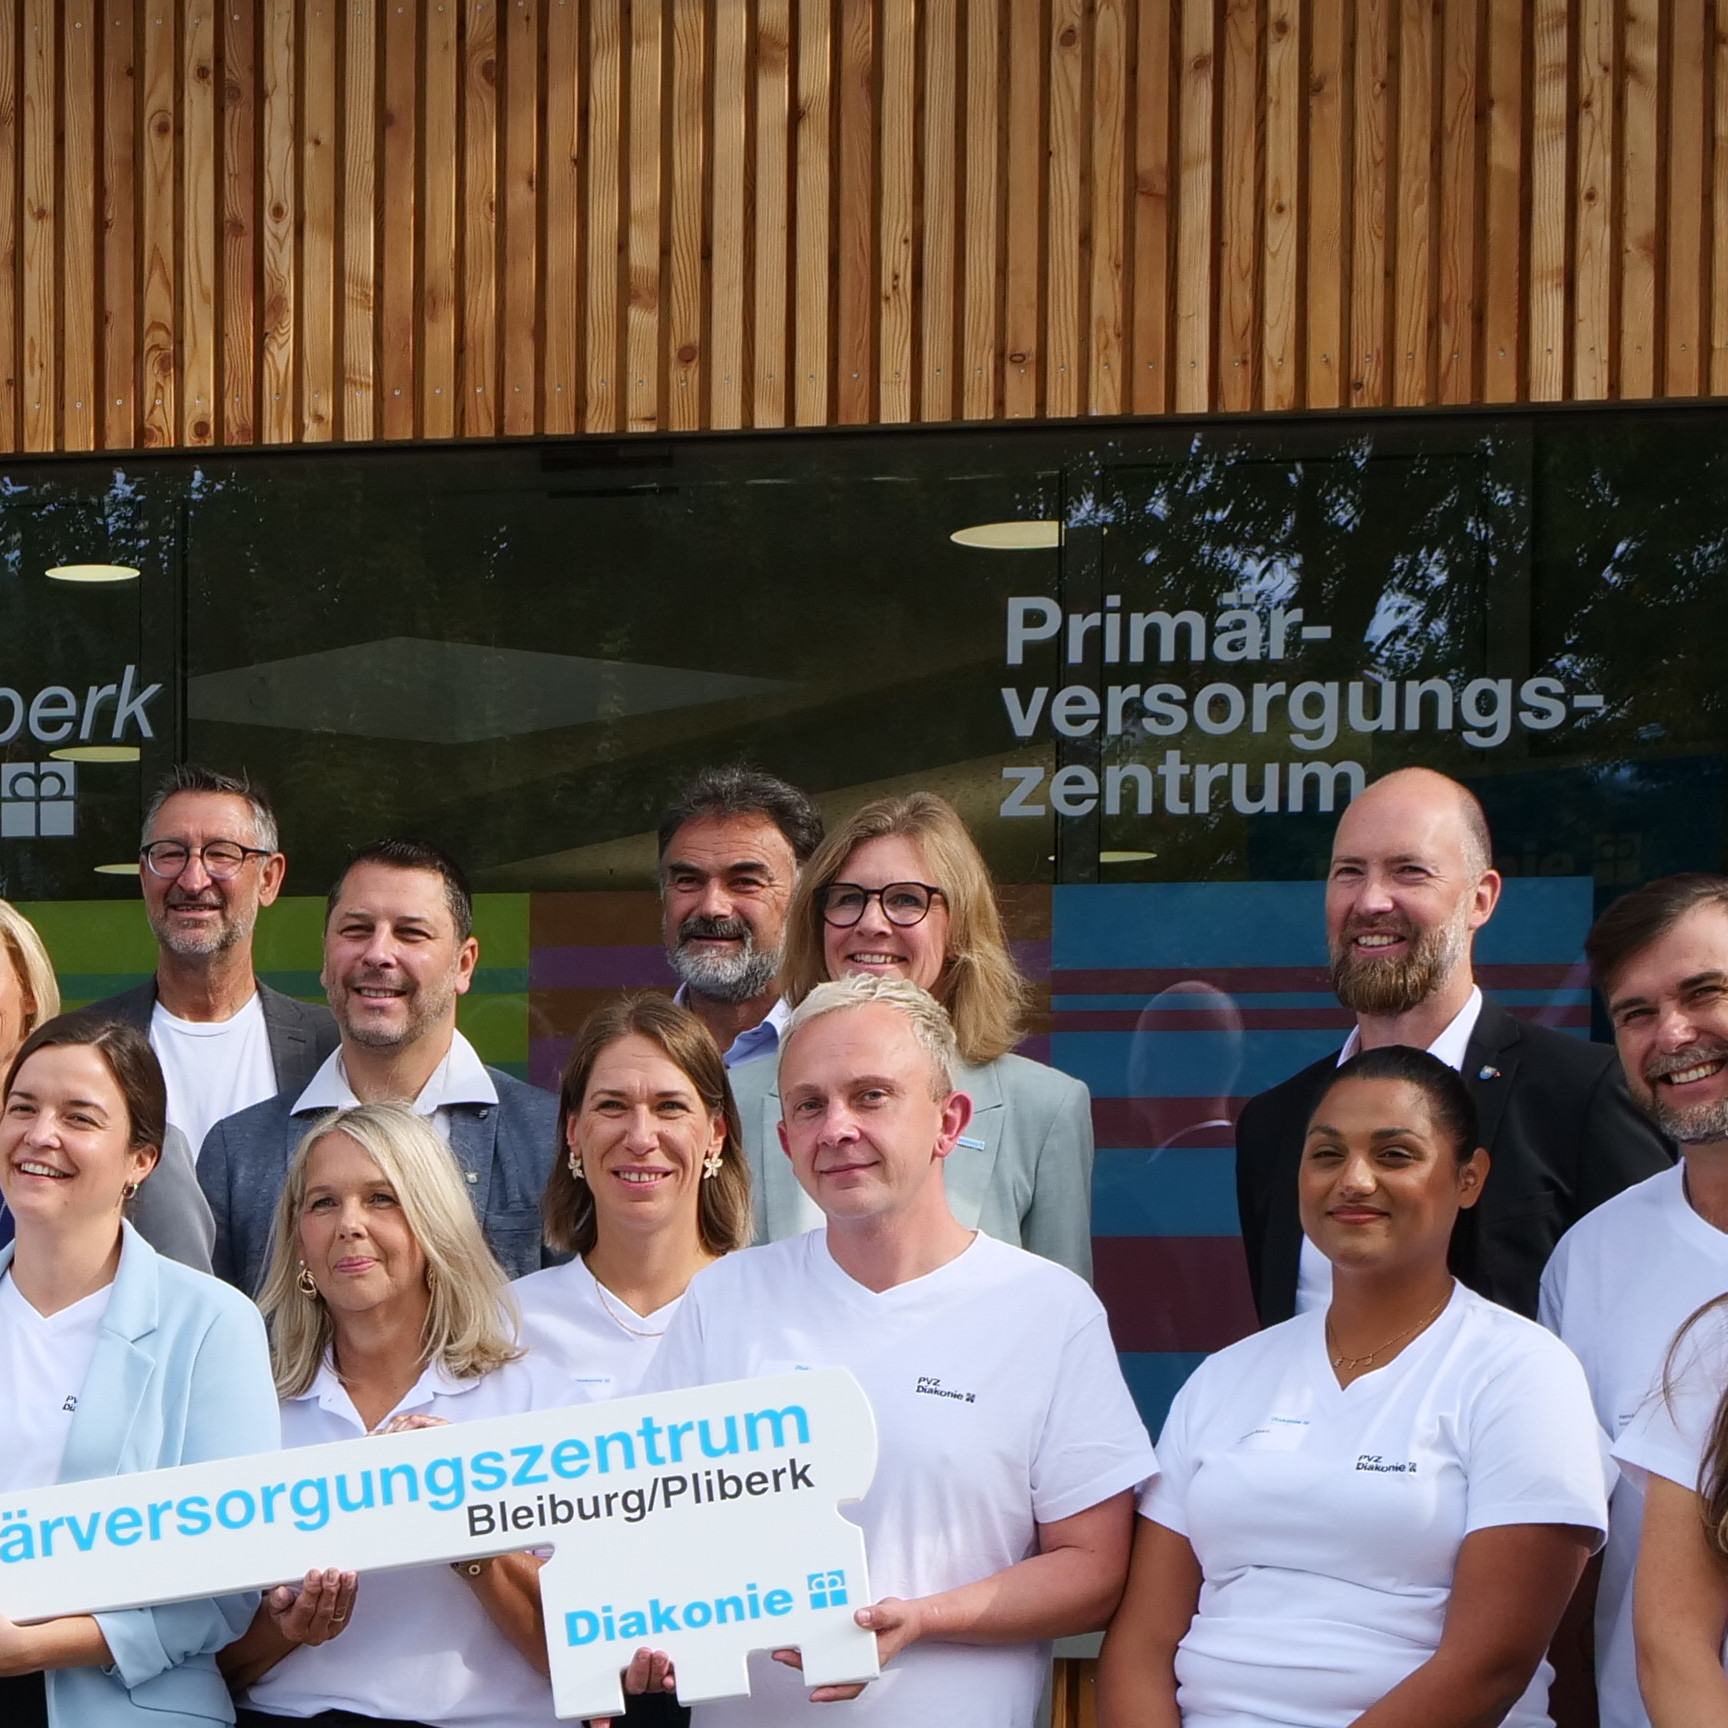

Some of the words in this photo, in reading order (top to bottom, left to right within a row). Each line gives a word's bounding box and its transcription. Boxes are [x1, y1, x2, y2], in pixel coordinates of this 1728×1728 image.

[1006, 590, 1332, 664] Primär-
[1001, 677, 1604, 749] versorgungs-
[1000, 749, 1366, 817] zentrum
[915, 1384, 964, 1401] Diakonie
[466, 1457, 815, 1538] Bleiburg/Pliberk
[1355, 1462, 1406, 1473] Diakonie
[564, 1582, 794, 1647] Diakonie
